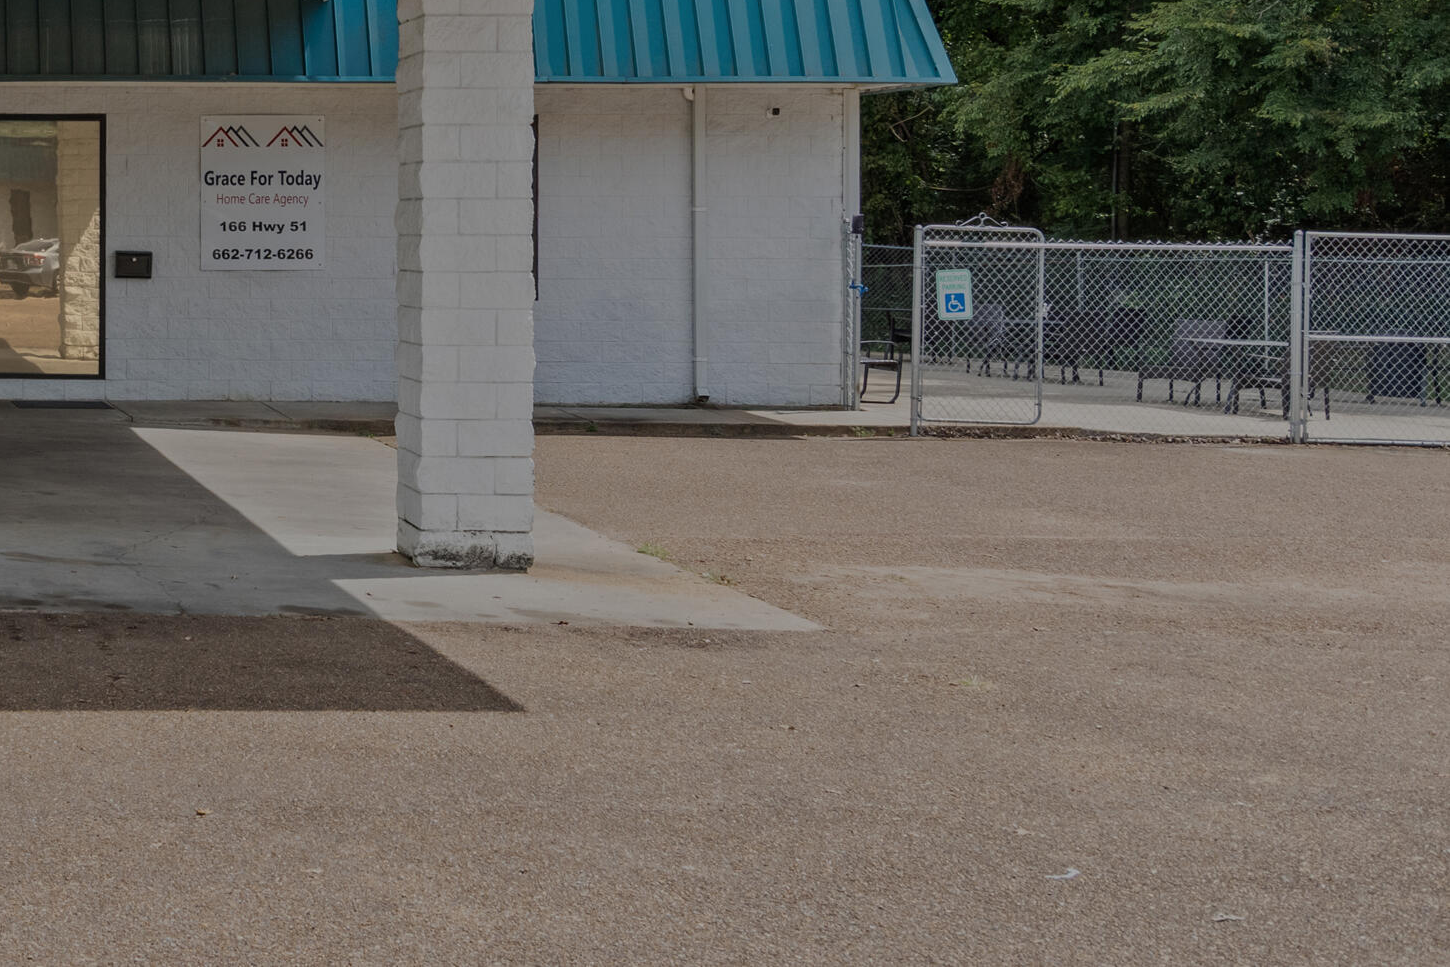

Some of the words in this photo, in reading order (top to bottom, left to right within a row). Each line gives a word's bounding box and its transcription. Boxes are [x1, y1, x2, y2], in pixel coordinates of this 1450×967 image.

[204, 170, 246, 186] Grace
[250, 171, 274, 186] For
[278, 170, 321, 190] Today
[216, 193, 245, 205] Home
[248, 193, 270, 205] Care
[273, 193, 309, 208] Agency
[220, 221, 247, 232] 166
[252, 221, 285, 234] Hwy
[290, 221, 307, 232] 51
[212, 248, 314, 260] 662-712-6266
